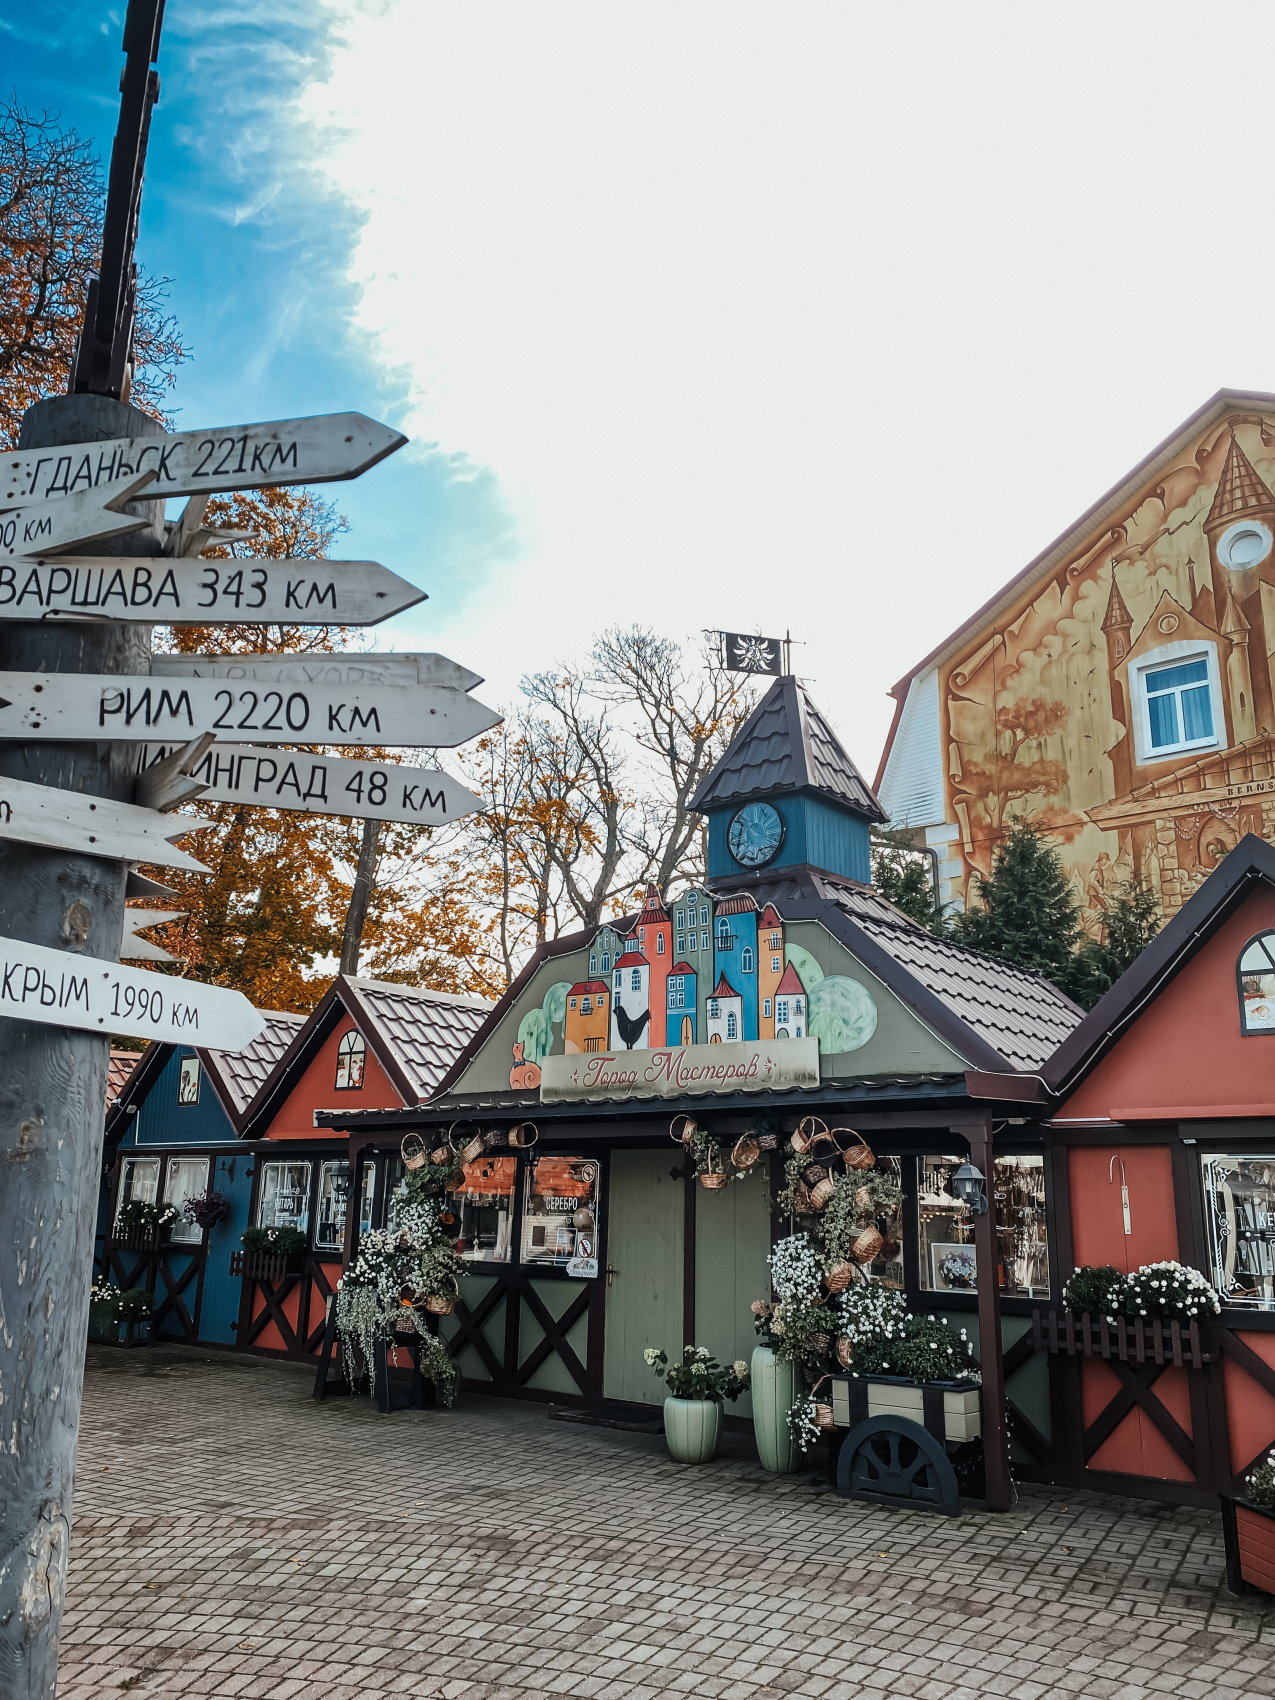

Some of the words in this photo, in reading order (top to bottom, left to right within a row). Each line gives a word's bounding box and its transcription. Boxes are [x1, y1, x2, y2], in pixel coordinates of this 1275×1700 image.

[29, 441, 184, 498] ГДАНЬСК
[0, 566, 181, 608] ВАРШАВА
[197, 568, 268, 609] 343
[98, 687, 195, 728] РИМ
[212, 689, 311, 731] 2220
[344, 770, 389, 807] 48
[1, 961, 90, 1012] КРЫМ
[110, 981, 164, 1024] 1990
[582, 1056, 639, 1095] Город
[644, 1049, 760, 1089] Мастеров
[546, 1196, 578, 1210] СЕРЕБРО
